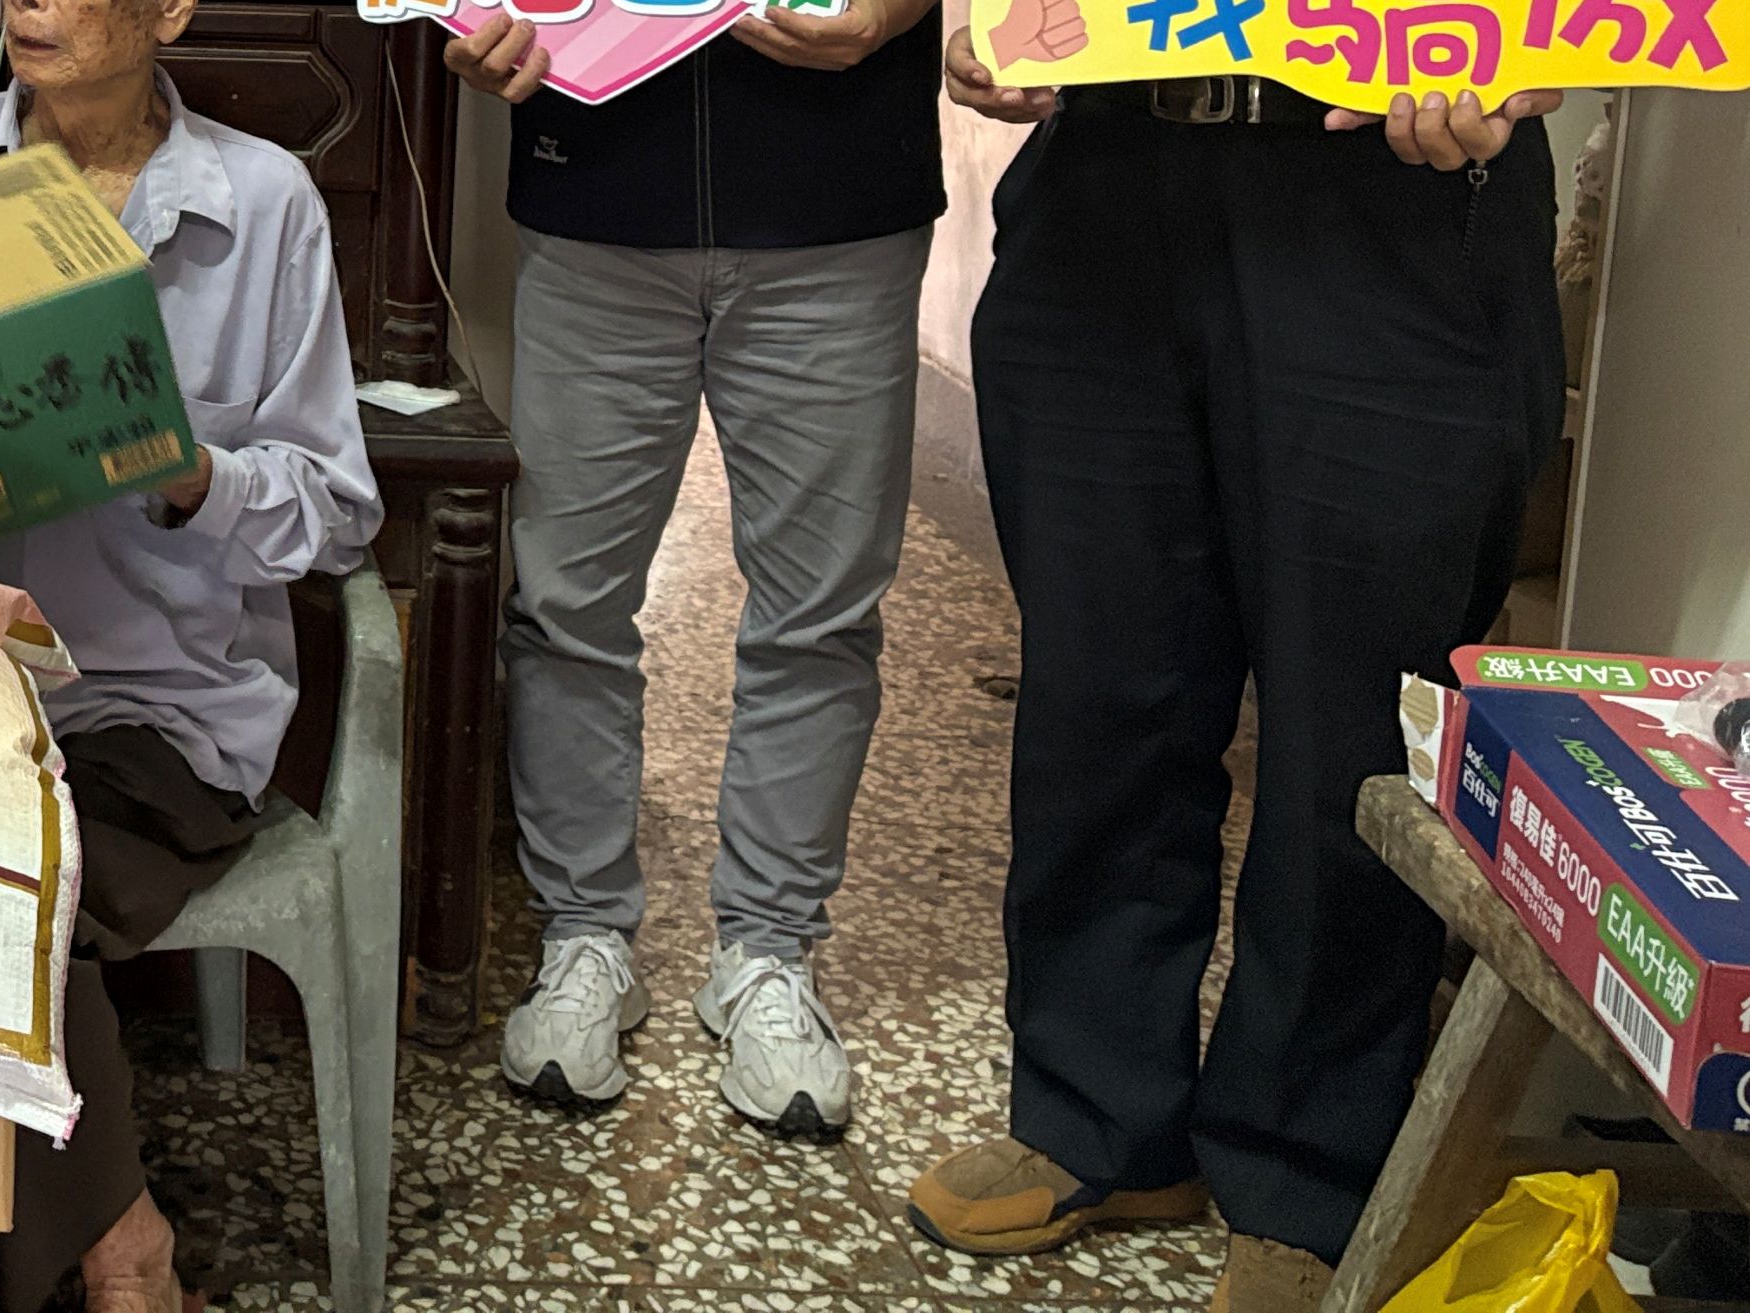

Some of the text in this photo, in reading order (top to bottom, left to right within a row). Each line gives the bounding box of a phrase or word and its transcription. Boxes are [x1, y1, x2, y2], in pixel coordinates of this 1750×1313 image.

[1484, 656, 1636, 686] EAA升級
[1462, 764, 1500, 819] 百仕可
[1556, 842, 1601, 917] 6000
[1623, 819, 1740, 901] 百仕可
[1607, 893, 1694, 1020] EAA升級
